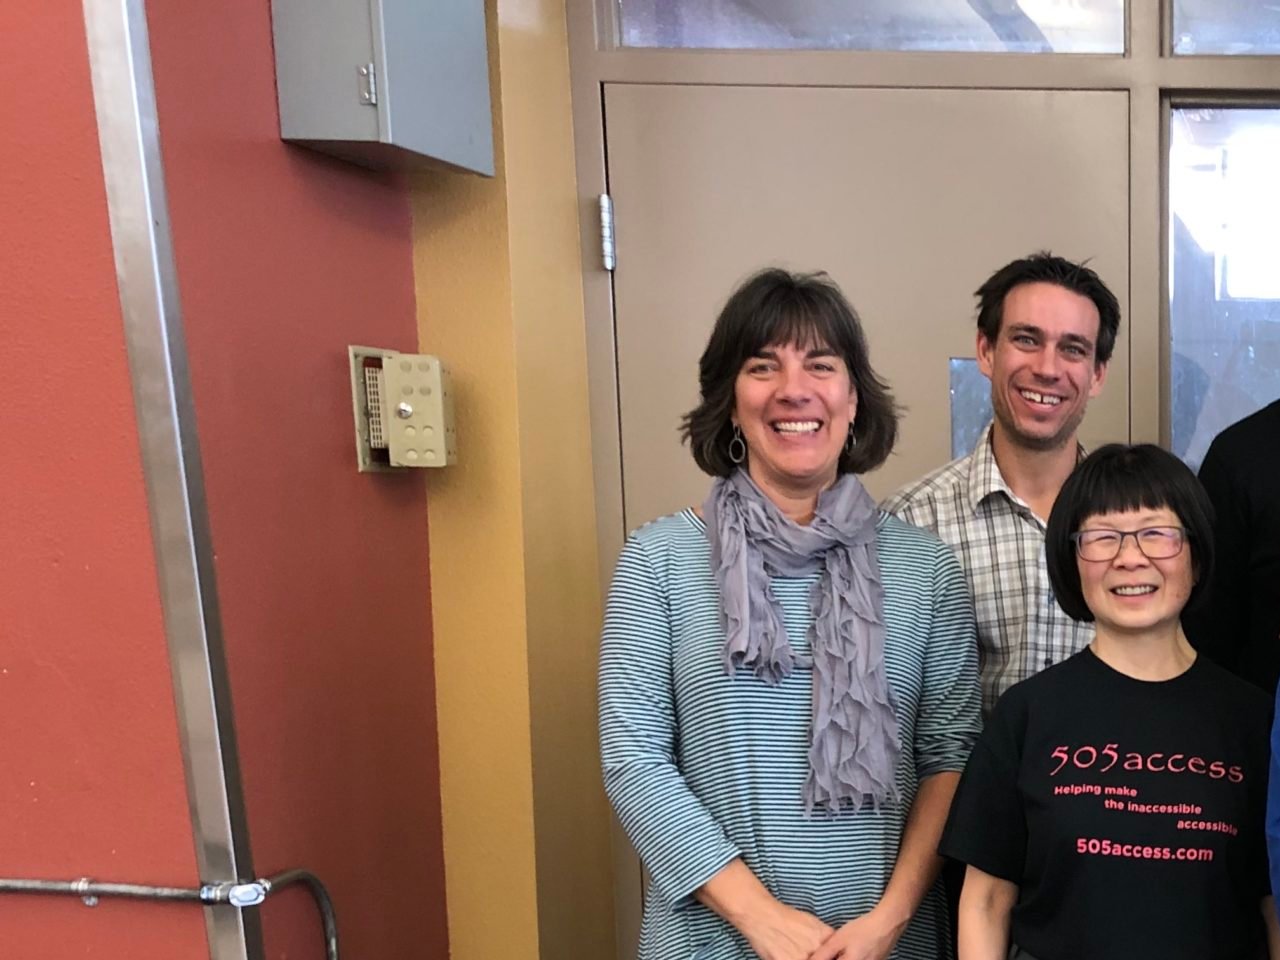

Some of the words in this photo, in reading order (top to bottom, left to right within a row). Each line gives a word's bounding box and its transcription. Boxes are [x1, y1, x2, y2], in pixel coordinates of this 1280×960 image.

[1050, 743, 1244, 783] 505access
[1054, 784, 1101, 796] Helping
[1104, 786, 1138, 797] make
[1104, 799, 1124, 810] the
[1128, 801, 1202, 815] inaccessible
[1177, 819, 1238, 836] accessible
[1076, 838, 1214, 861] 505access.com
